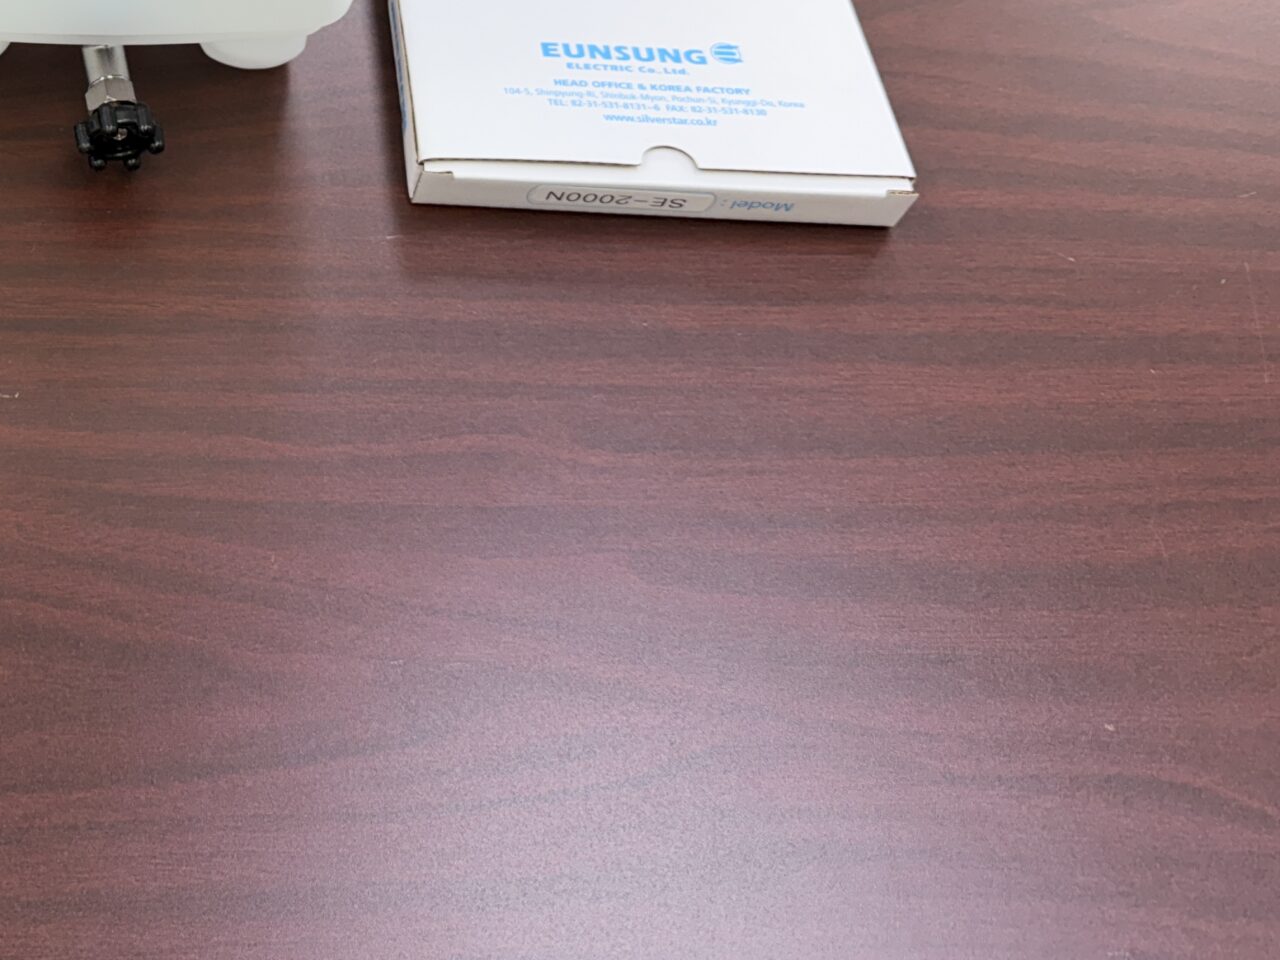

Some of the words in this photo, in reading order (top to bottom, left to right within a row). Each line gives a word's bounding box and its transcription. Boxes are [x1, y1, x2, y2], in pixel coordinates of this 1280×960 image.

[540, 41, 708, 66] EUNSUNG
[566, 62, 633, 73] ELECTRIC
[553, 78, 588, 88] HEAD
[592, 80, 633, 90] OFFICE
[649, 83, 693, 93] KOREA
[695, 86, 751, 96] FACTORY
[545, 190, 688, 209] SE-2000N
